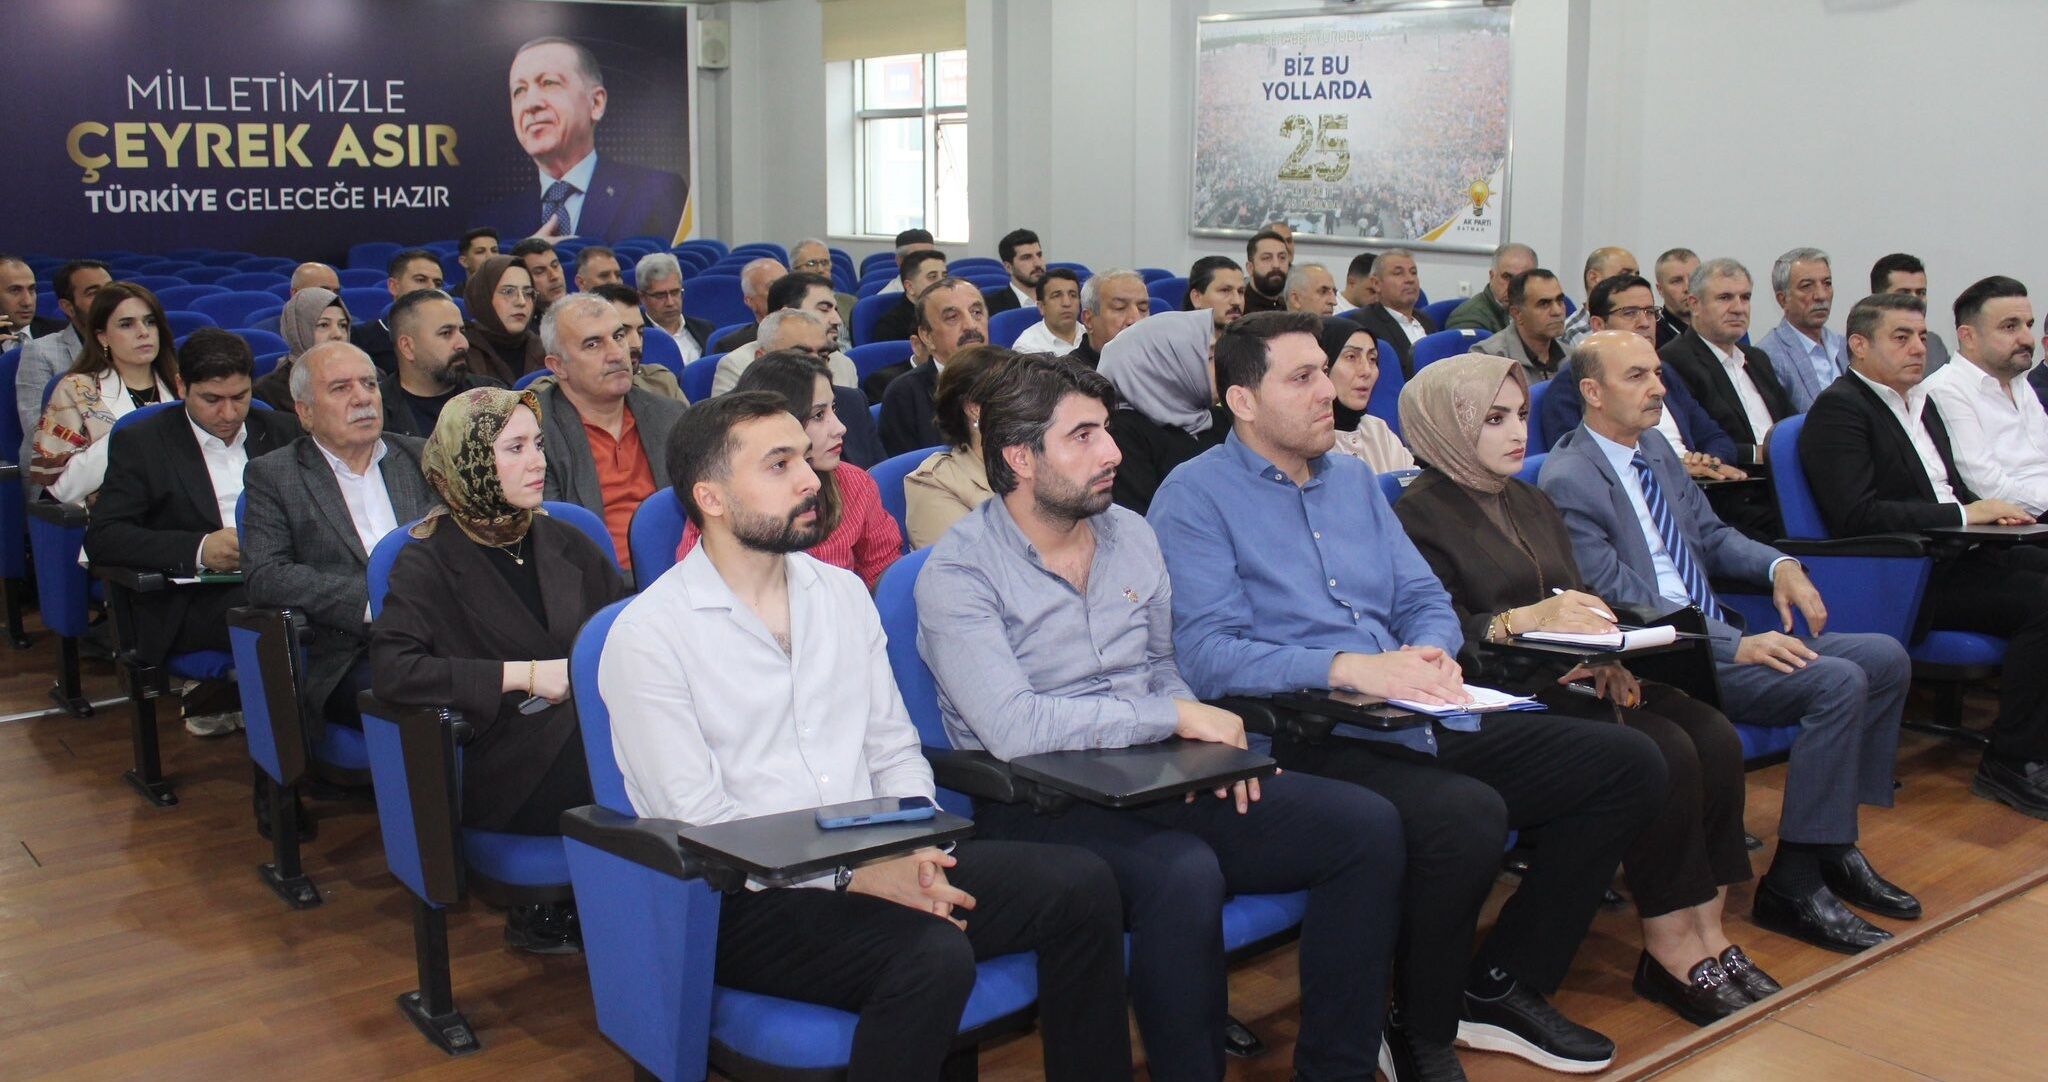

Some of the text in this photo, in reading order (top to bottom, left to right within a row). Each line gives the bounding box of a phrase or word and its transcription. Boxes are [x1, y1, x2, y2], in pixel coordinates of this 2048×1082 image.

[1284, 52, 1349, 77] BİZ BU
[126, 69, 406, 114] MİLLETİMİZLE
[1262, 80, 1372, 101] YOLLARDA
[66, 121, 461, 184] ÇEYREK ASIR
[1278, 113, 1351, 182] 25
[85, 181, 450, 213] TÜRKİYE GELECEĞE HAZIR
